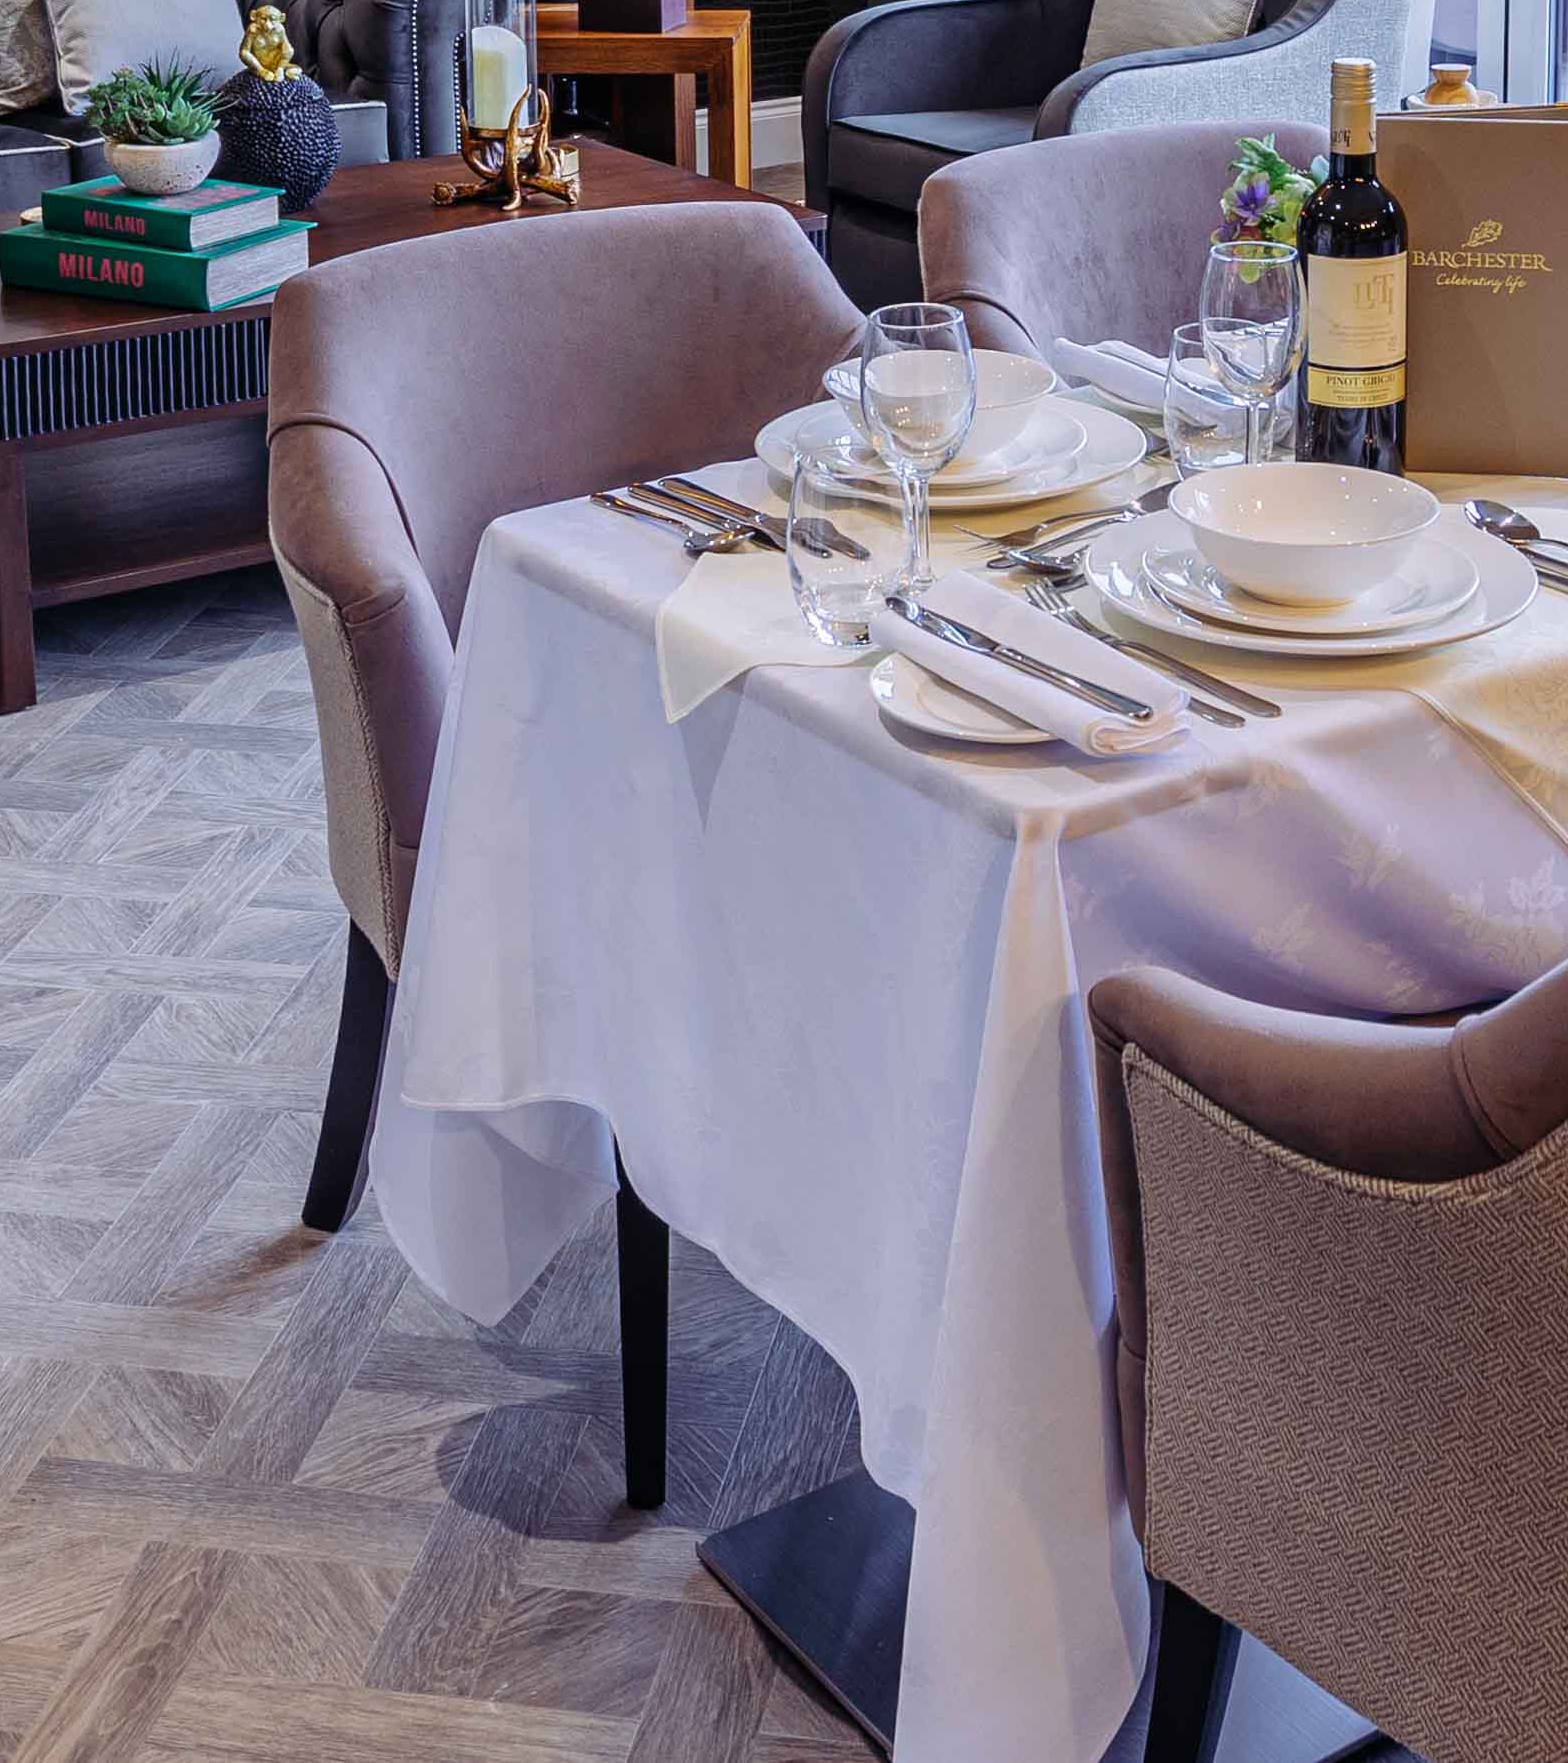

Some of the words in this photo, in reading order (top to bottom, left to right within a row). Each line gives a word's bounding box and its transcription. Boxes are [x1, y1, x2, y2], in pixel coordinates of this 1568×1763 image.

[84, 209, 146, 236] MILANO
[58, 252, 145, 288] MILANO
[1412, 250, 1553, 272] BARCHESTER
[1435, 272, 1503, 294] Celebrating
[1504, 274, 1528, 294] life
[1326, 374, 1360, 387] PINOT
